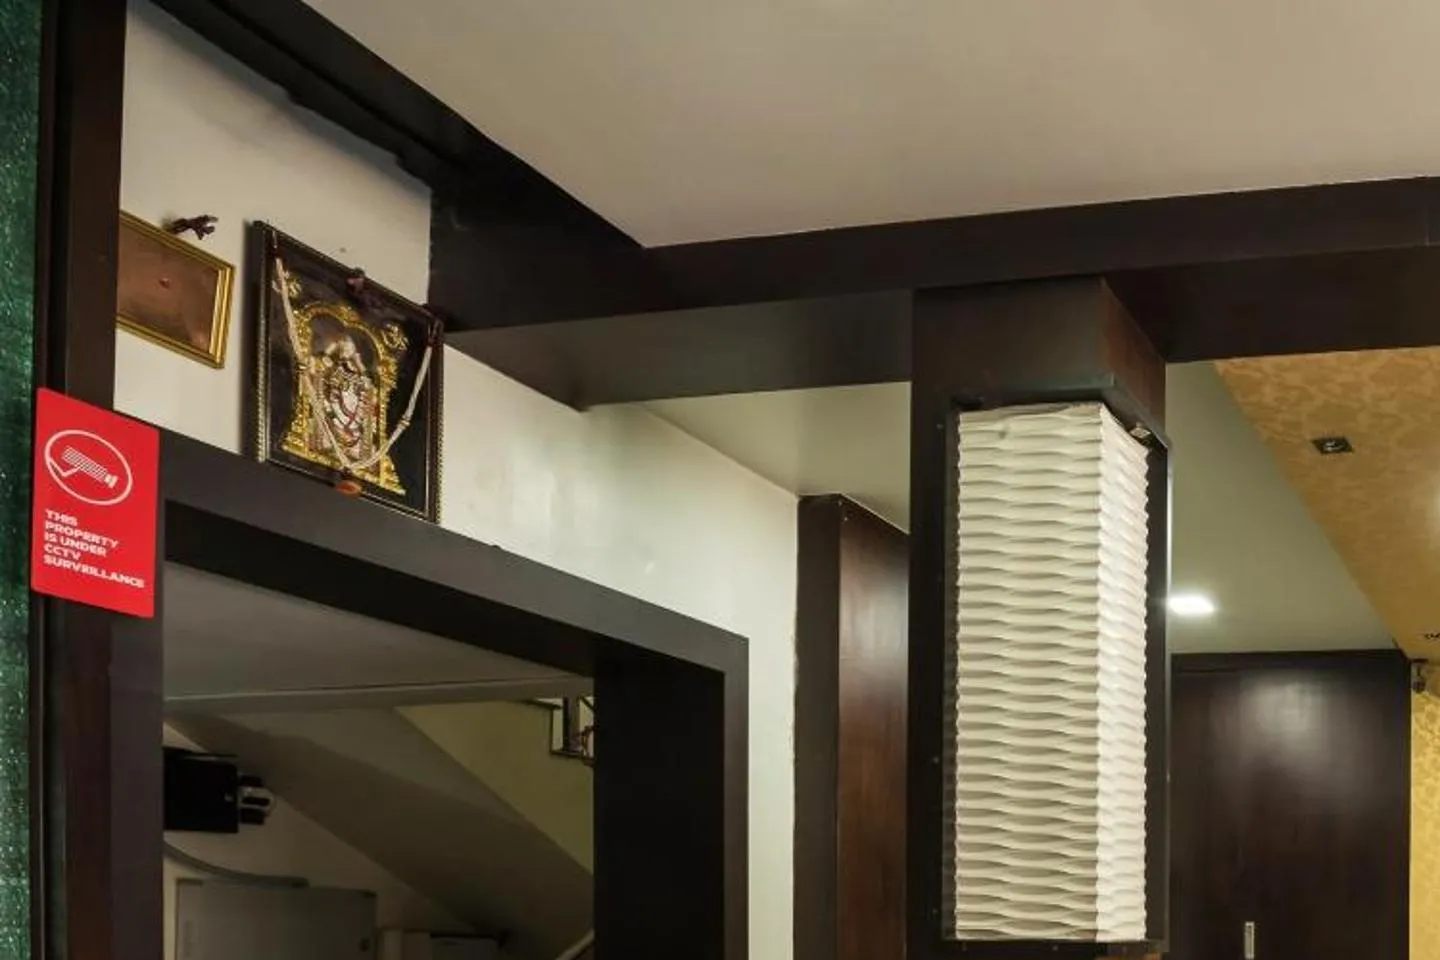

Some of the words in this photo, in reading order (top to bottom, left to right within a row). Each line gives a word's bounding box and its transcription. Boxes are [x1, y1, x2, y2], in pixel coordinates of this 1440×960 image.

[45, 508, 78, 527] THIS
[45, 520, 119, 549] PROPERTY
[45, 533, 57, 543] IS
[60, 536, 107, 557] UNDER
[44, 543, 81, 562] CCTV
[43, 554, 145, 589] SURVEILLANCE
